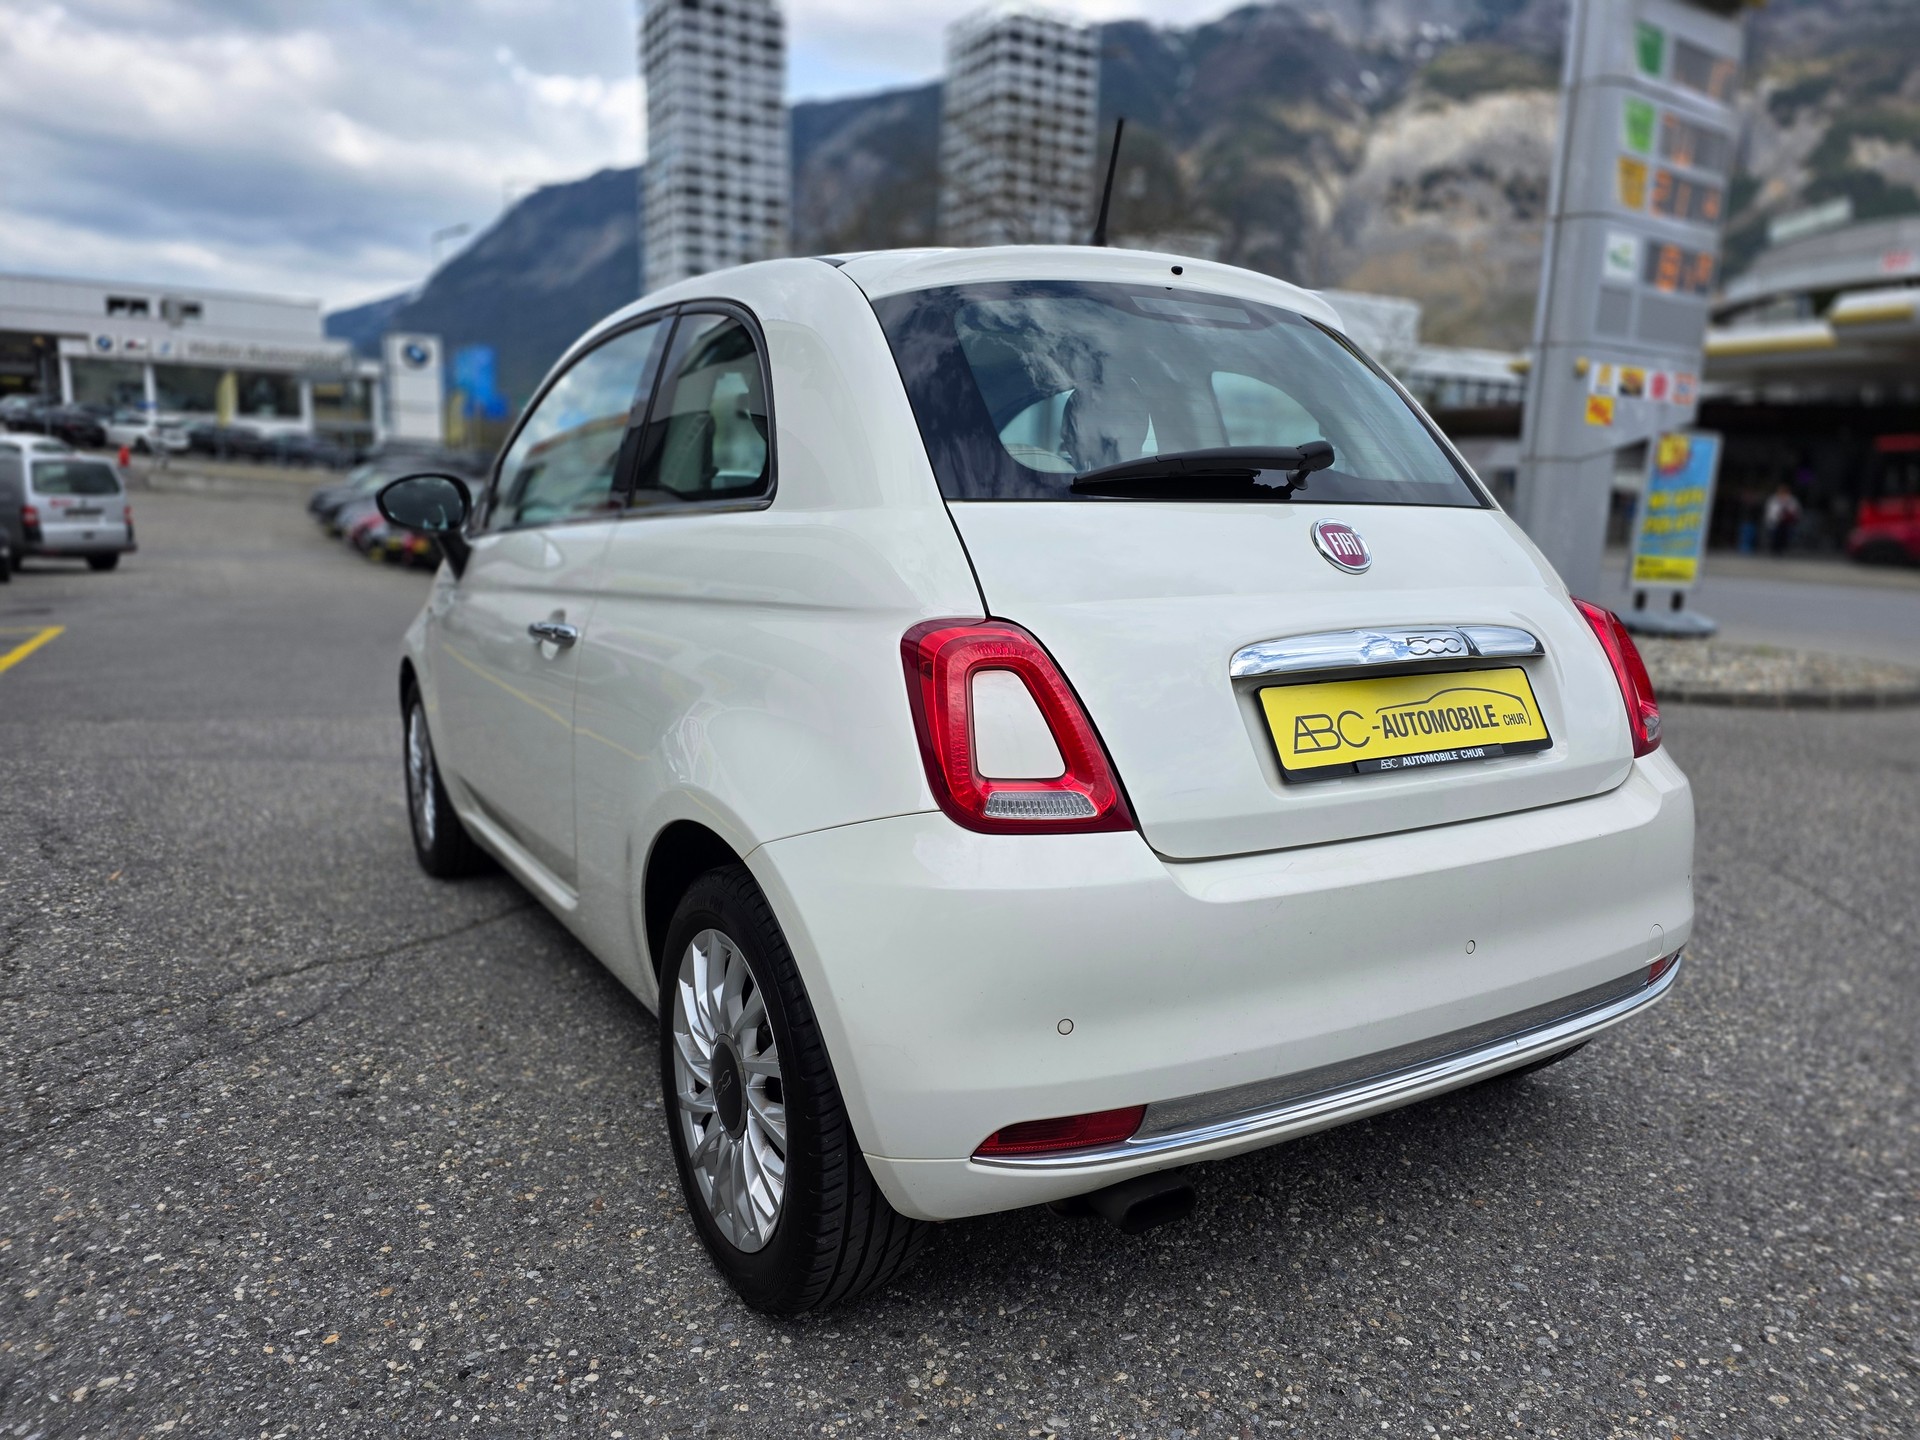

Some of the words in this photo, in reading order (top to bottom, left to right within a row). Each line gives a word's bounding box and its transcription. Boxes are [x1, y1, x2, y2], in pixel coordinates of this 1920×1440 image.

[1326, 532, 1362, 556] FIAT
[1405, 636, 1462, 655] 500
[1503, 712, 1527, 726] CHUR
[1402, 751, 1459, 767] AUTOMOBILE
[1460, 748, 1485, 759] CHUR
